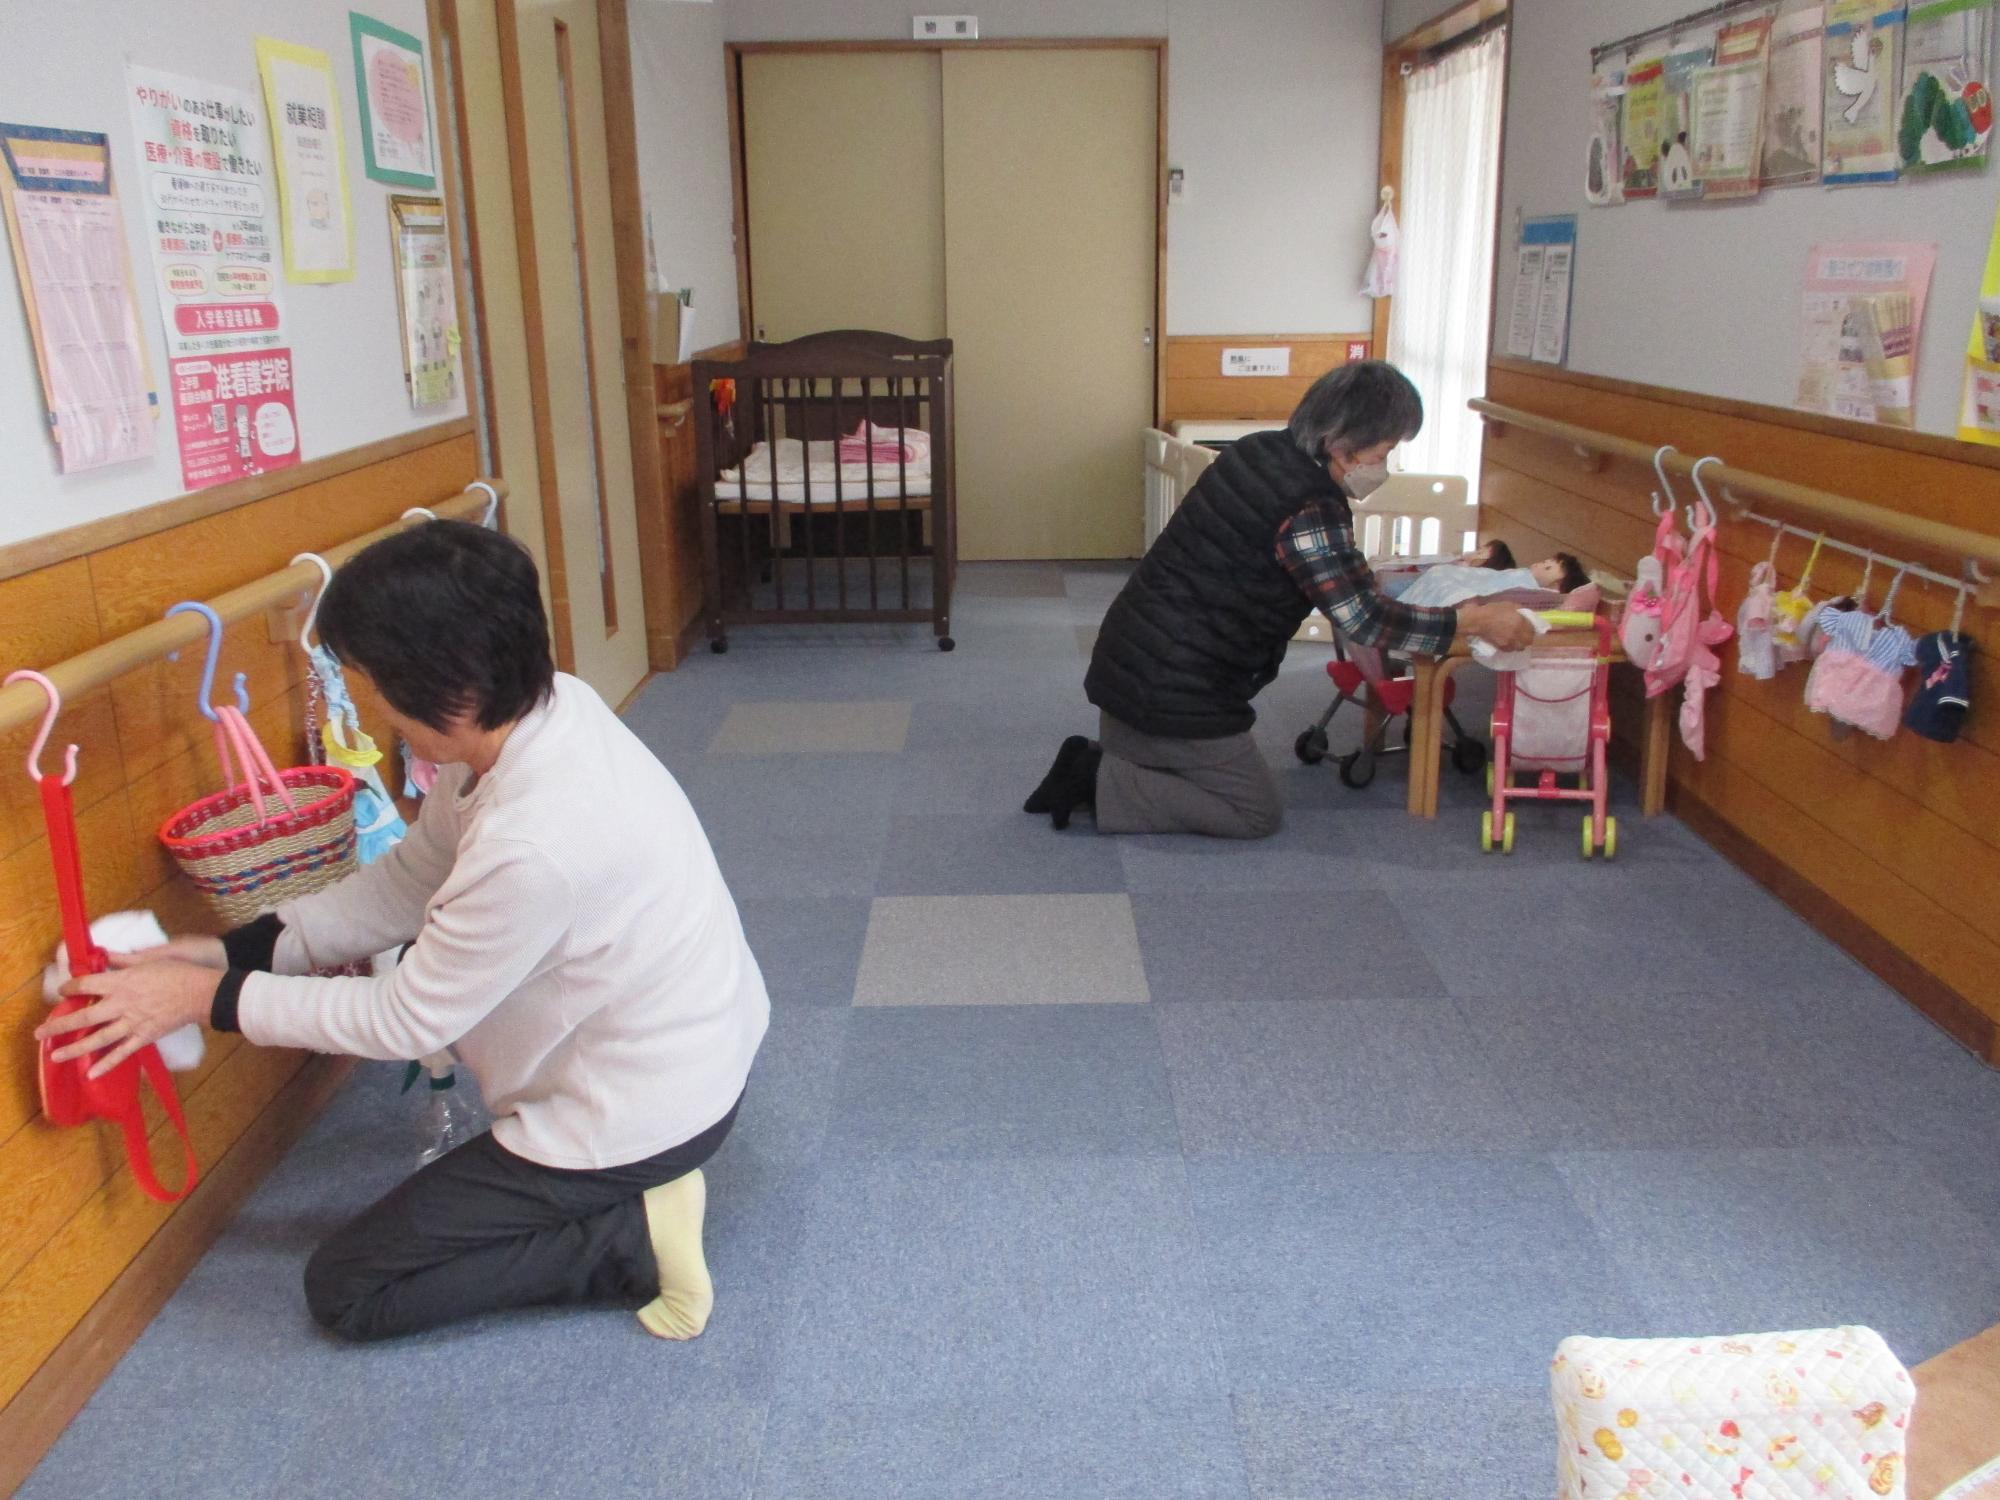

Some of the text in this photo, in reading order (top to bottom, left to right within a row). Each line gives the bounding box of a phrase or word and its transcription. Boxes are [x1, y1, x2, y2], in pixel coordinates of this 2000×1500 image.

[286, 102, 327, 130] 就業相談
[170, 118, 238, 148] 資格を取りたい
[195, 307, 263, 329] 入学希望者募集
[212, 357, 290, 400] 准看護学院
